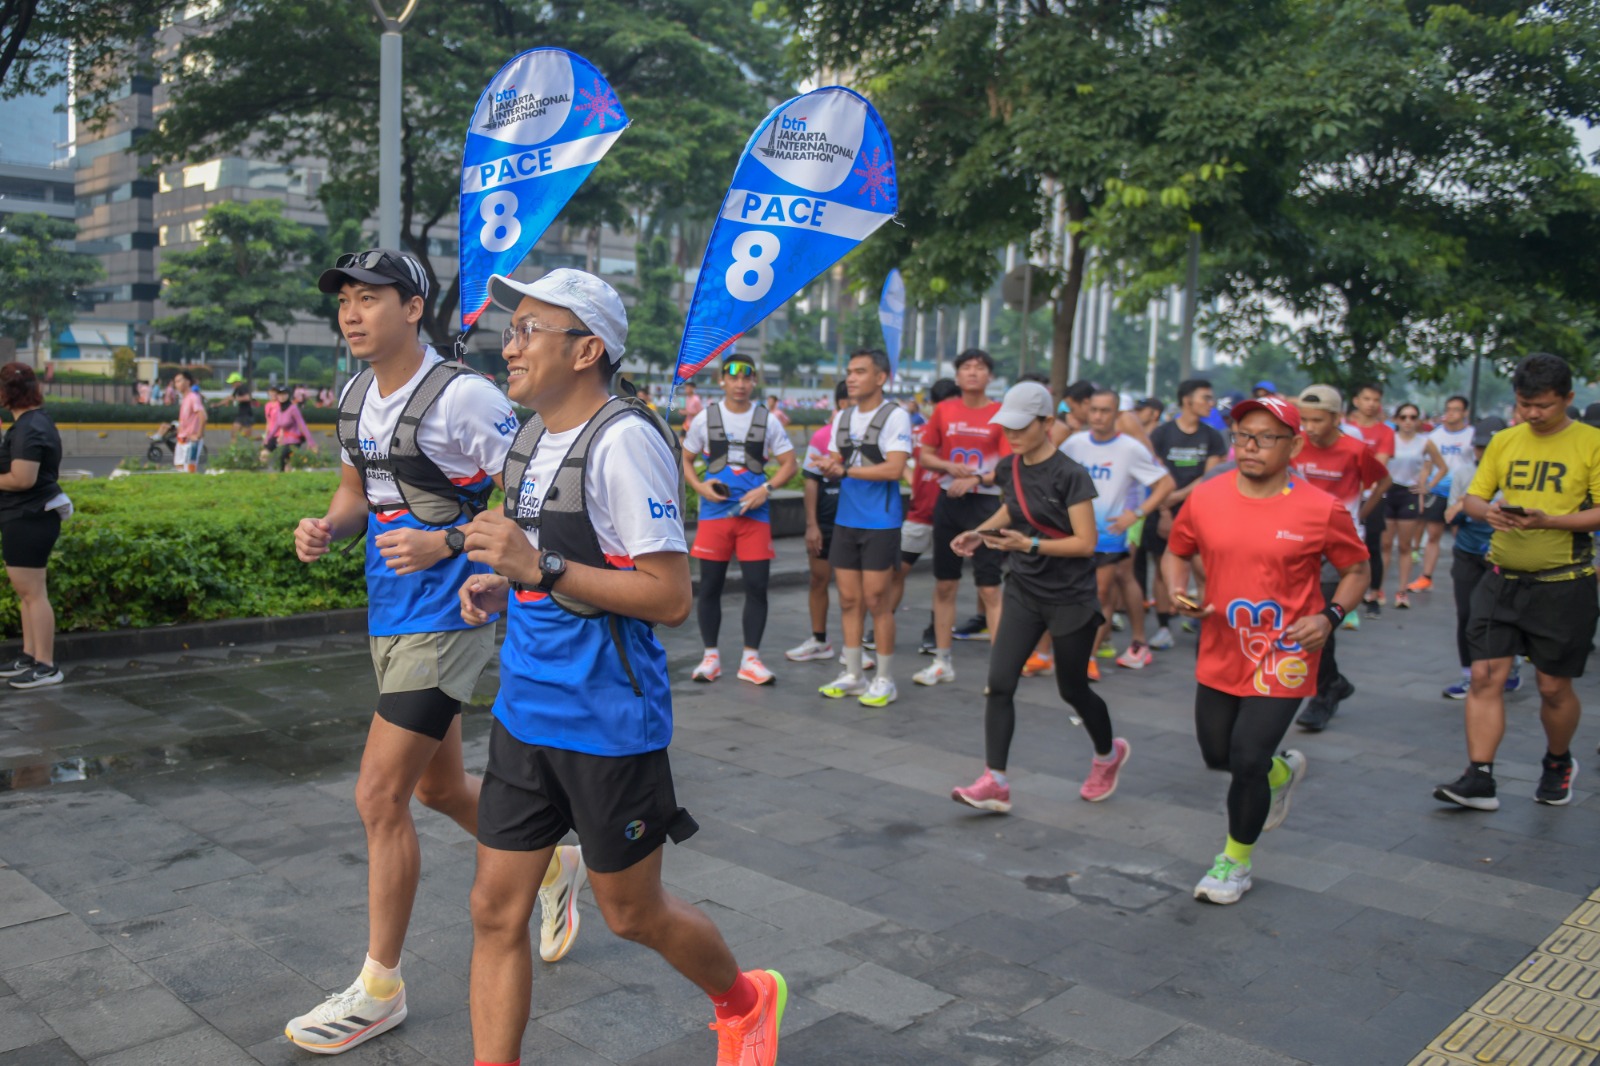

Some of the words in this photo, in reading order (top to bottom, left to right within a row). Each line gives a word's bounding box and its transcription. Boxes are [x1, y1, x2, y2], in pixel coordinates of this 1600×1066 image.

[494, 93, 535, 112] JAKARTA
[496, 84, 516, 102] btn
[495, 94, 570, 120] INTERNATIONAL
[497, 107, 546, 128] MARATHON
[781, 115, 807, 131] btn
[778, 130, 827, 142] JAKARTA
[775, 151, 834, 163] MARATHON
[776, 140, 853, 160] INTERNATIONAL
[480, 148, 552, 187] PACE
[741, 192, 826, 227] PACE
[480, 190, 521, 252] 8
[725, 230, 780, 302] 8
[648, 498, 677, 520] btn
